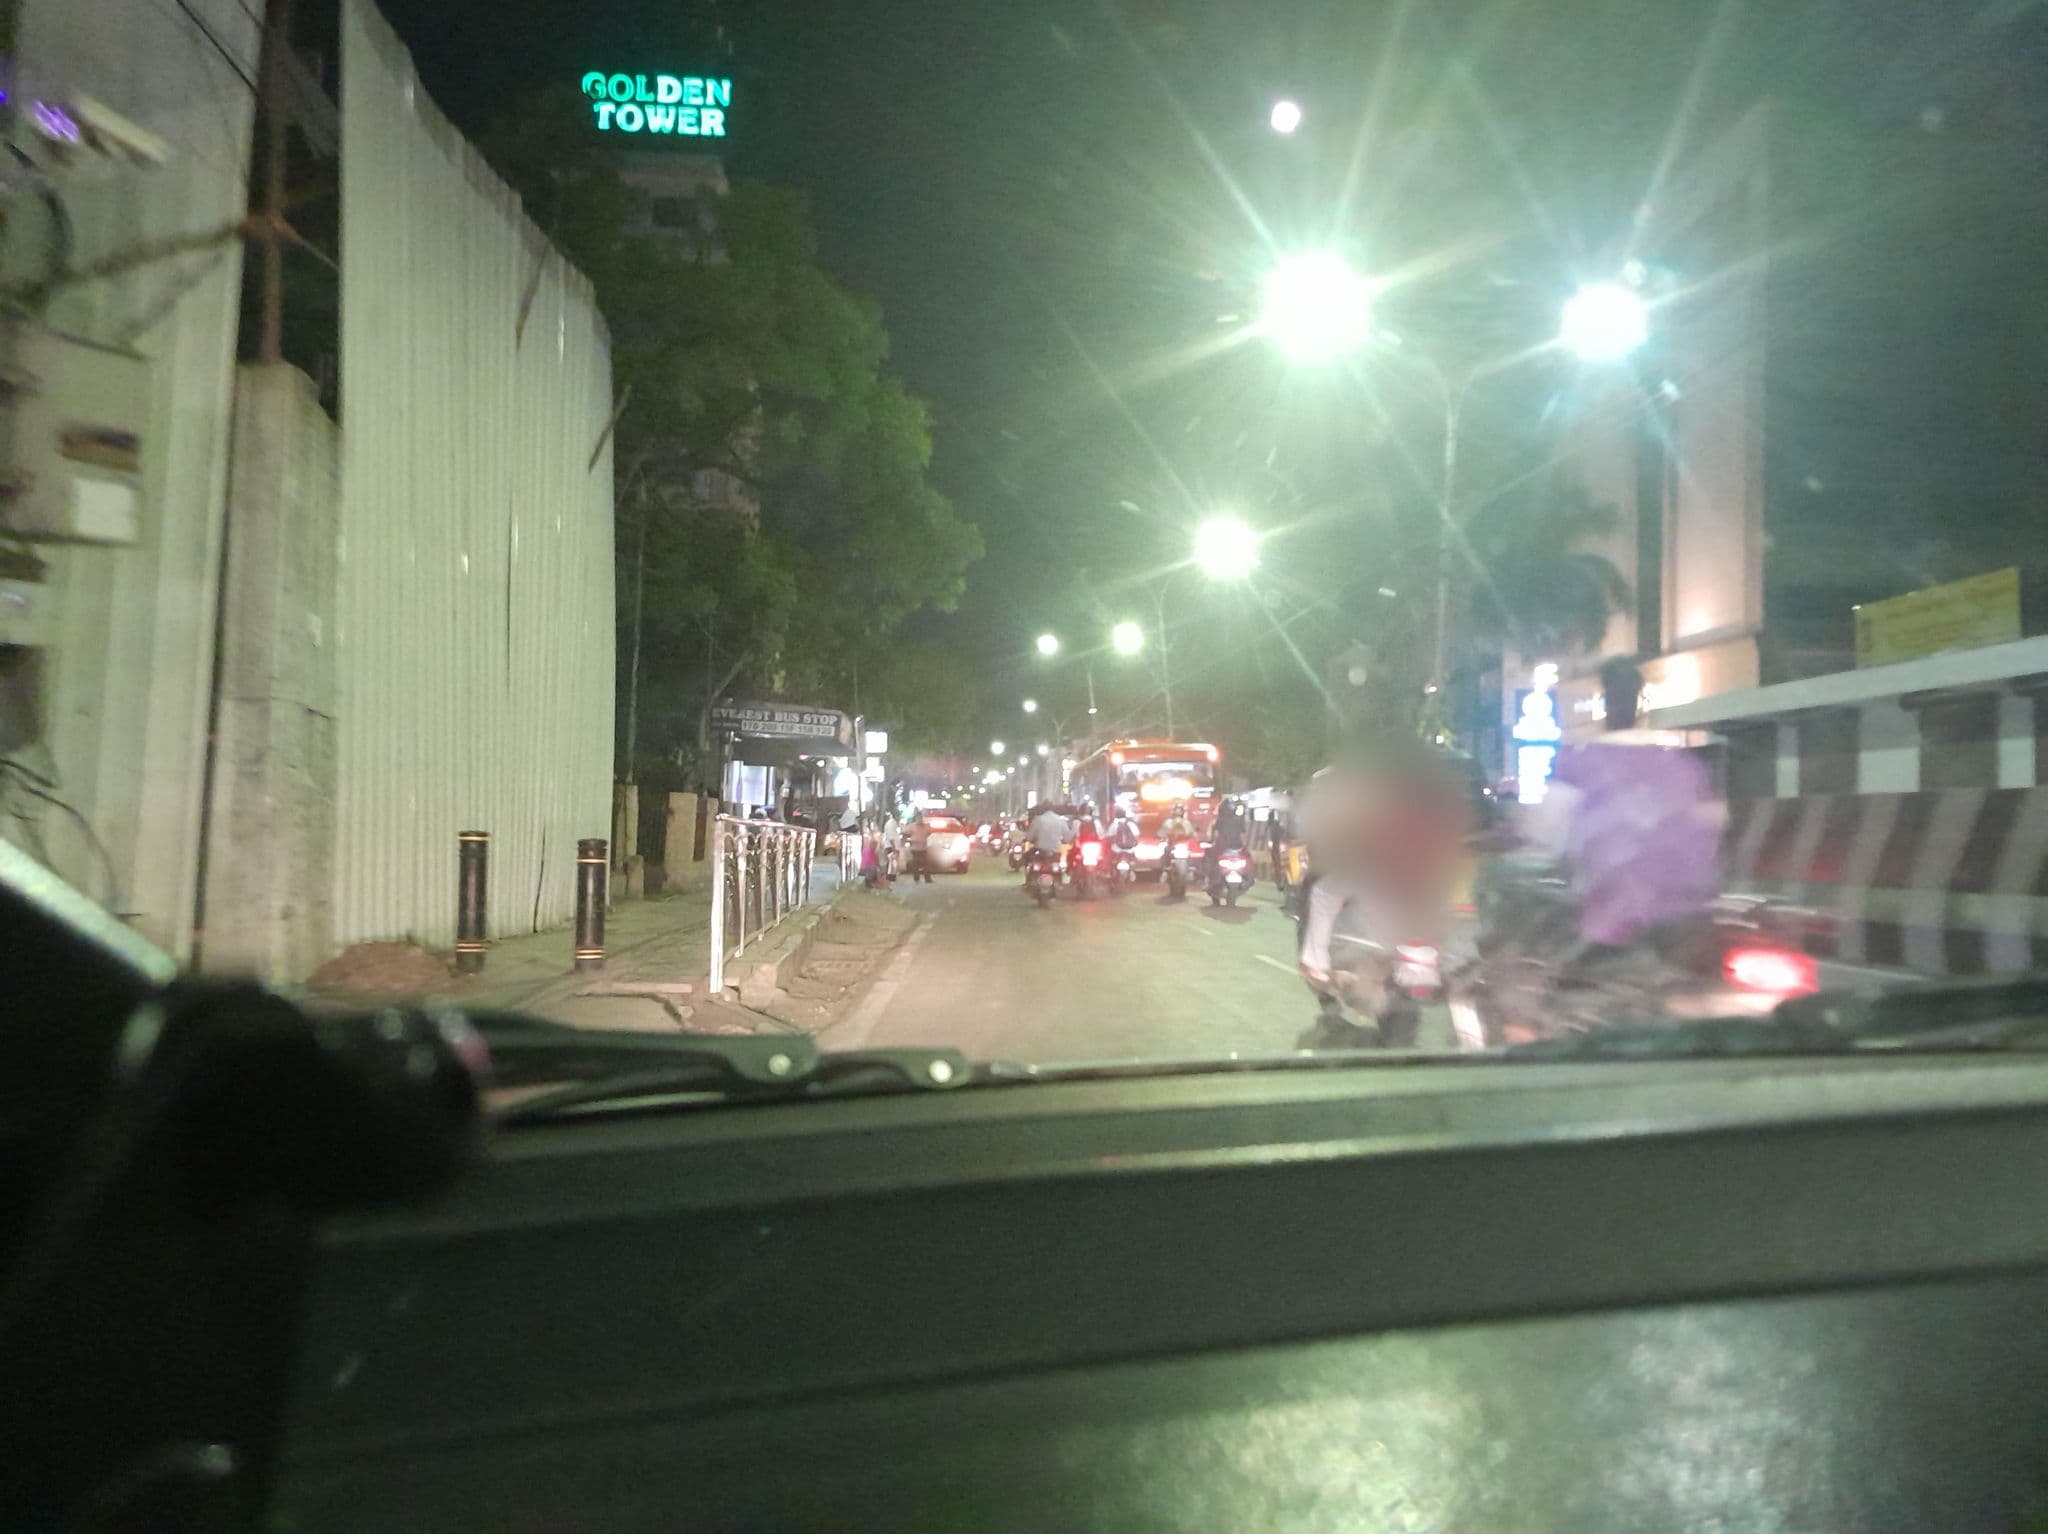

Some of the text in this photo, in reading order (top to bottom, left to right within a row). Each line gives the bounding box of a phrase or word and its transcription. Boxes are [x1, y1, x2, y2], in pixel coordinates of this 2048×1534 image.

[582, 71, 731, 107] GOLDEN
[593, 101, 726, 136] TOWER
[774, 710, 800, 723] BUS
[803, 713, 838, 726] STOP
